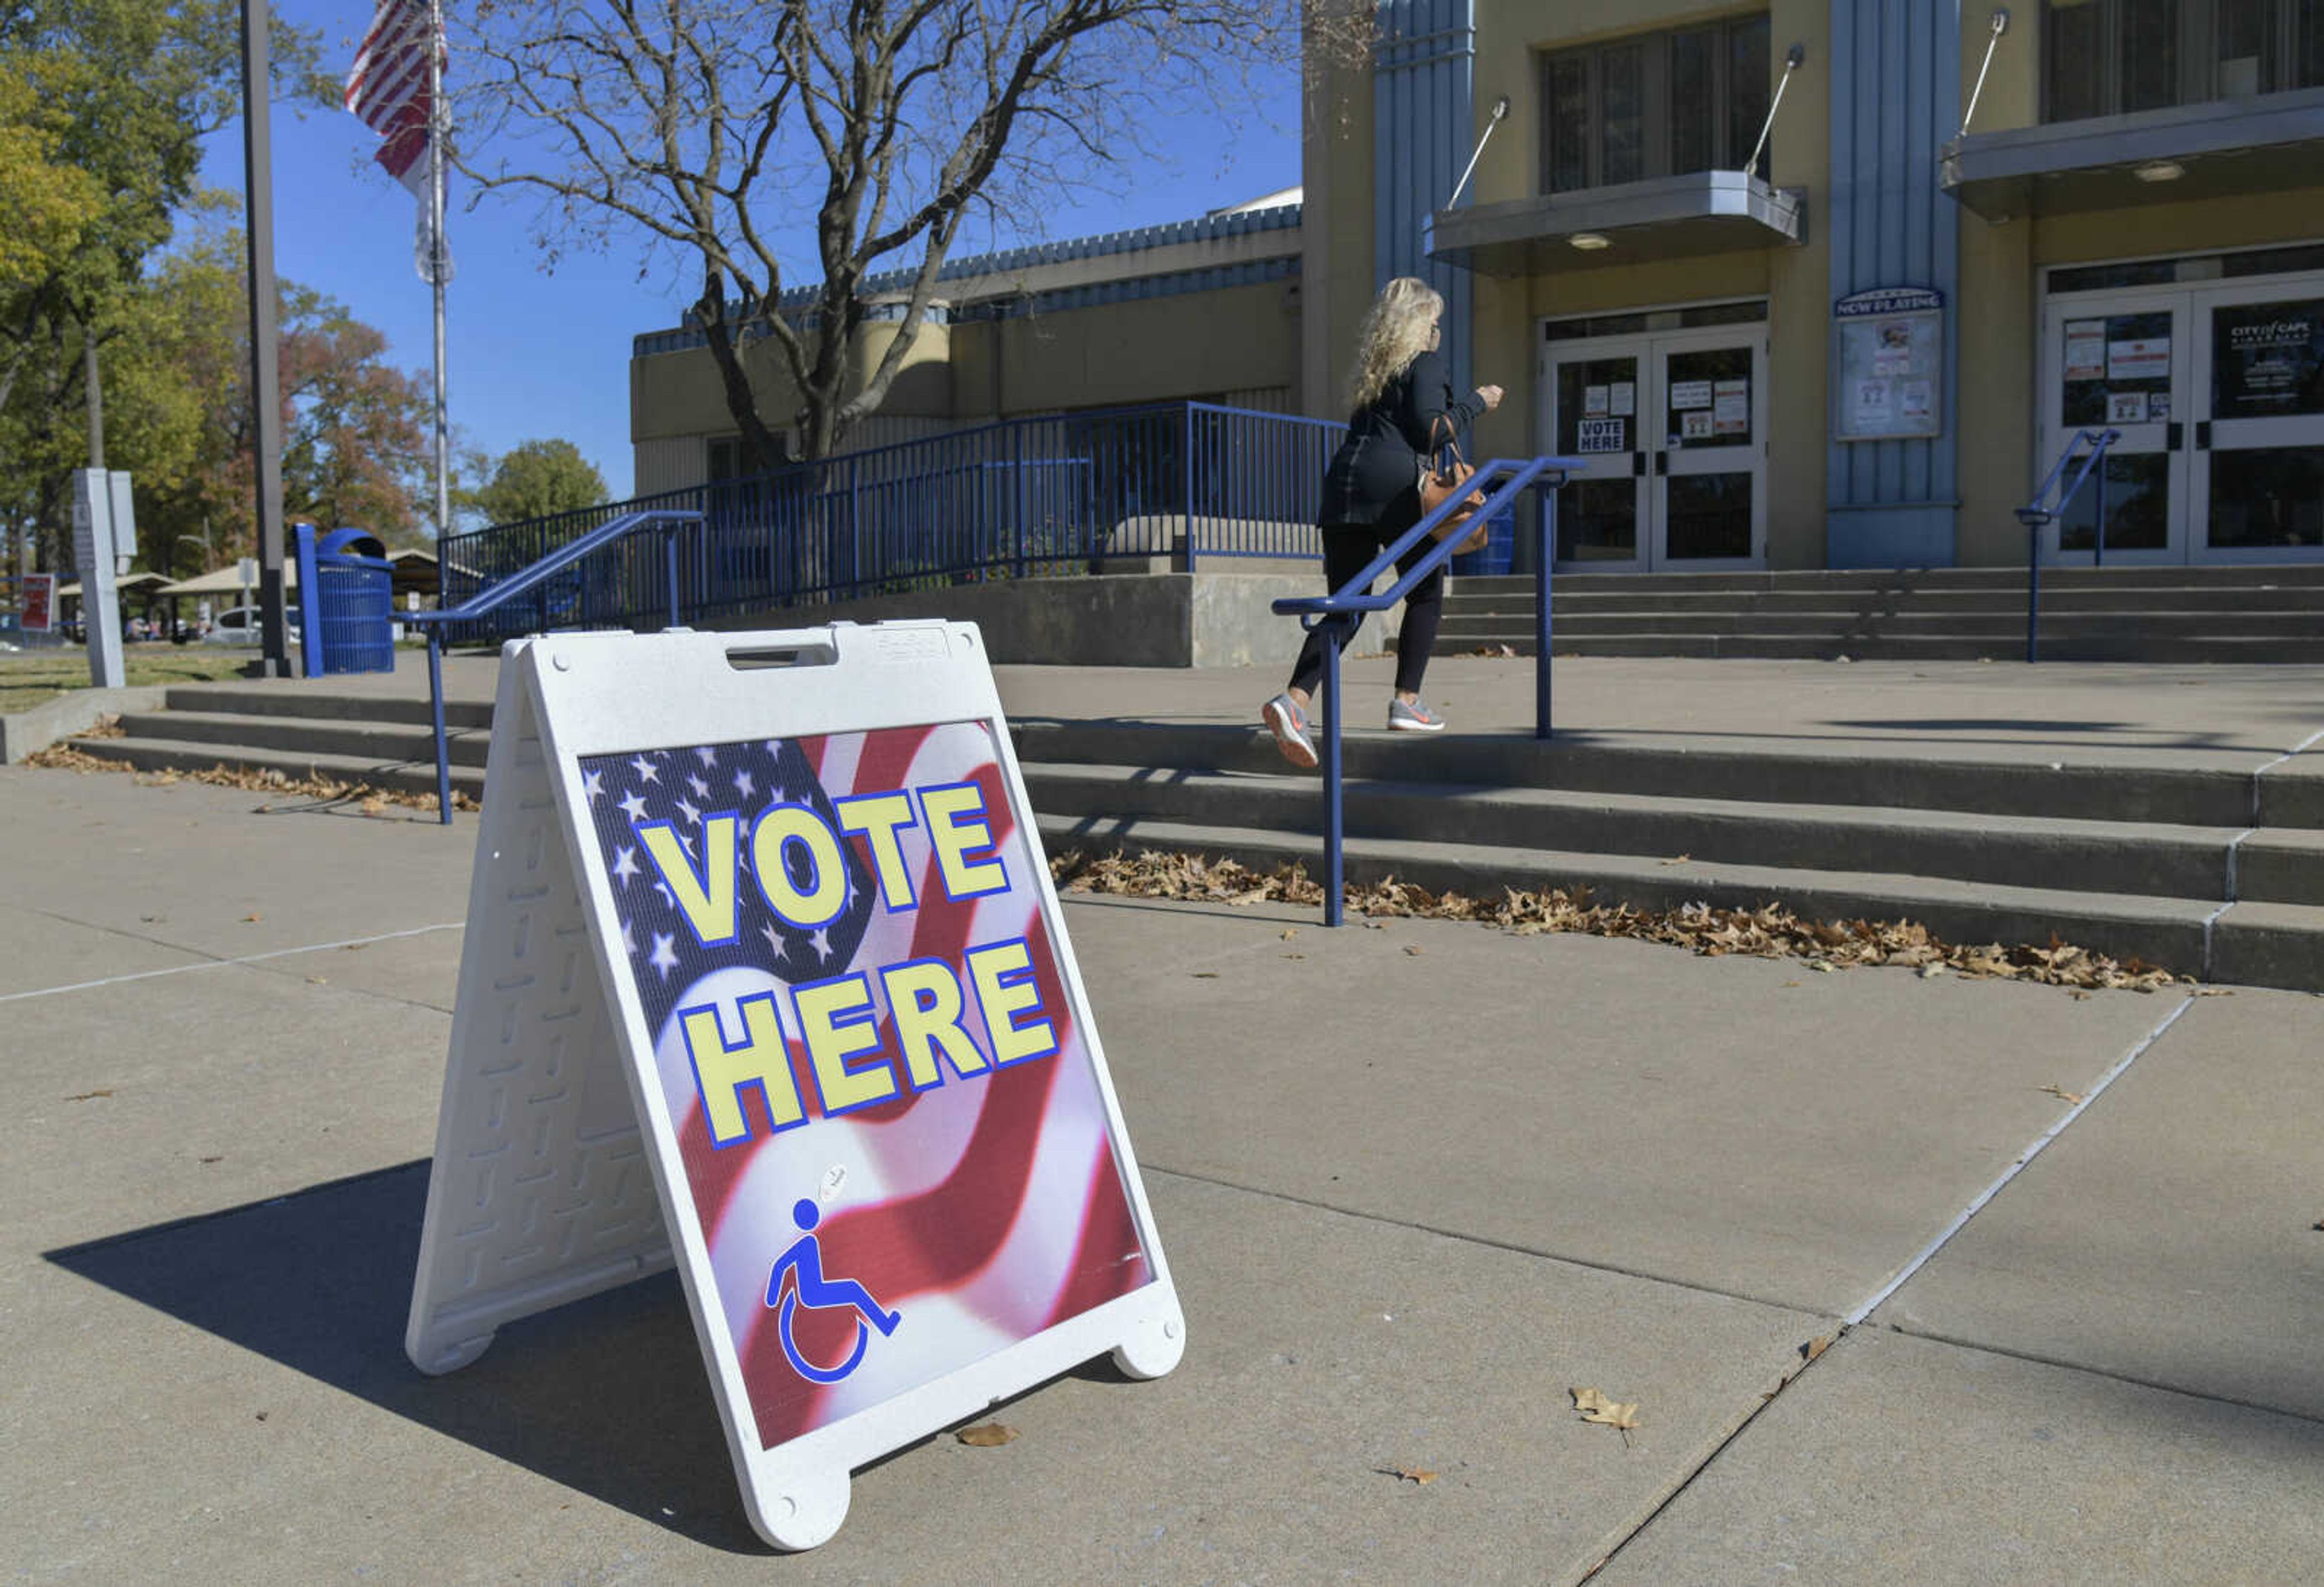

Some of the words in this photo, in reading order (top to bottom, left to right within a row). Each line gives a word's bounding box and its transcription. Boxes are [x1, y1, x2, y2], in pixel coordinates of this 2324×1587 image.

[1837, 302, 1871, 315] NOW
[1582, 422, 1621, 435] VOTE
[1581, 436, 1621, 450] HERE
[632, 780, 1011, 949] VOTE
[678, 937, 1060, 1150] HERE
